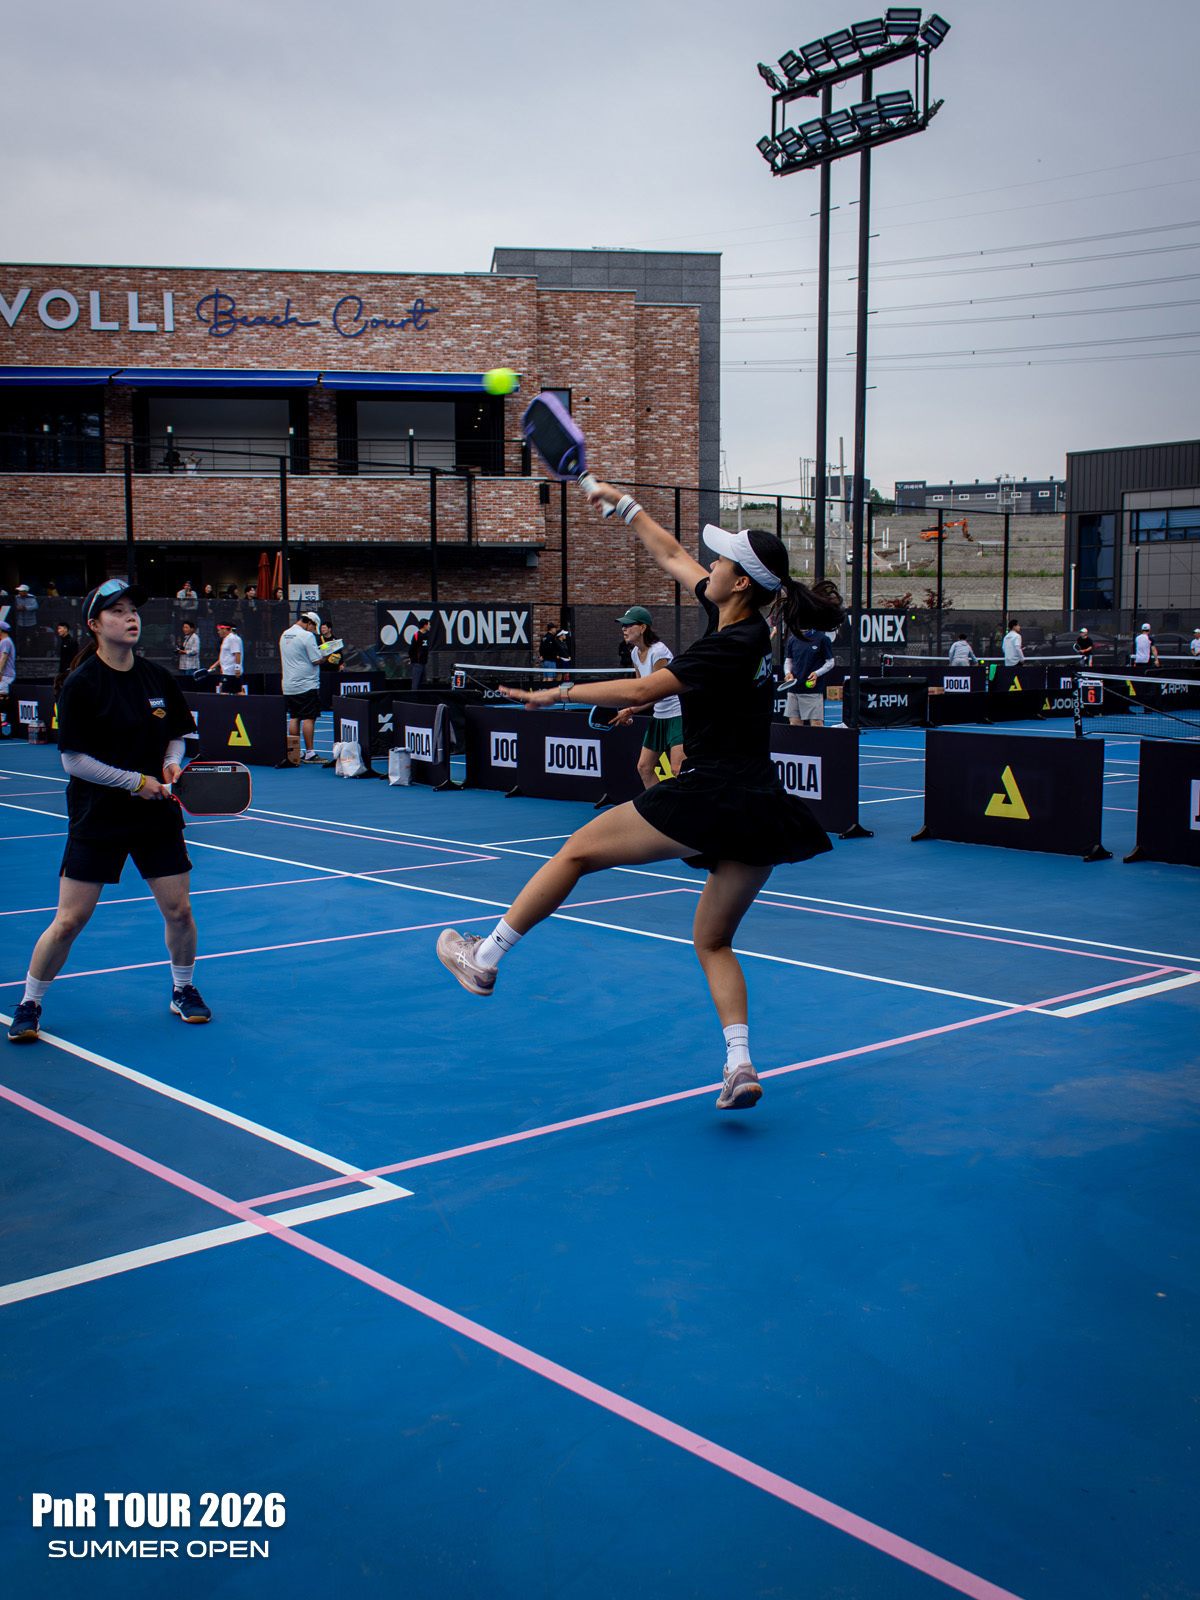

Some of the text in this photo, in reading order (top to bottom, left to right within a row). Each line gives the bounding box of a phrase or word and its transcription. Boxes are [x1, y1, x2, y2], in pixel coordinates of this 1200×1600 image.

[196, 288, 320, 337] Beach
[333, 295, 439, 338] Court
[439, 609, 529, 645] YONEX
[847, 613, 906, 643] ONEX
[945, 679, 970, 690] JOOLA
[1087, 689, 1096, 703] 6
[1167, 683, 1189, 694] RPM
[20, 704, 39, 720] JOOLA
[879, 694, 909, 708] RPM
[407, 731, 431, 756] JOOLA
[493, 738, 518, 763] JOO
[547, 743, 598, 771] JOOLA
[776, 760, 819, 792] OOLA
